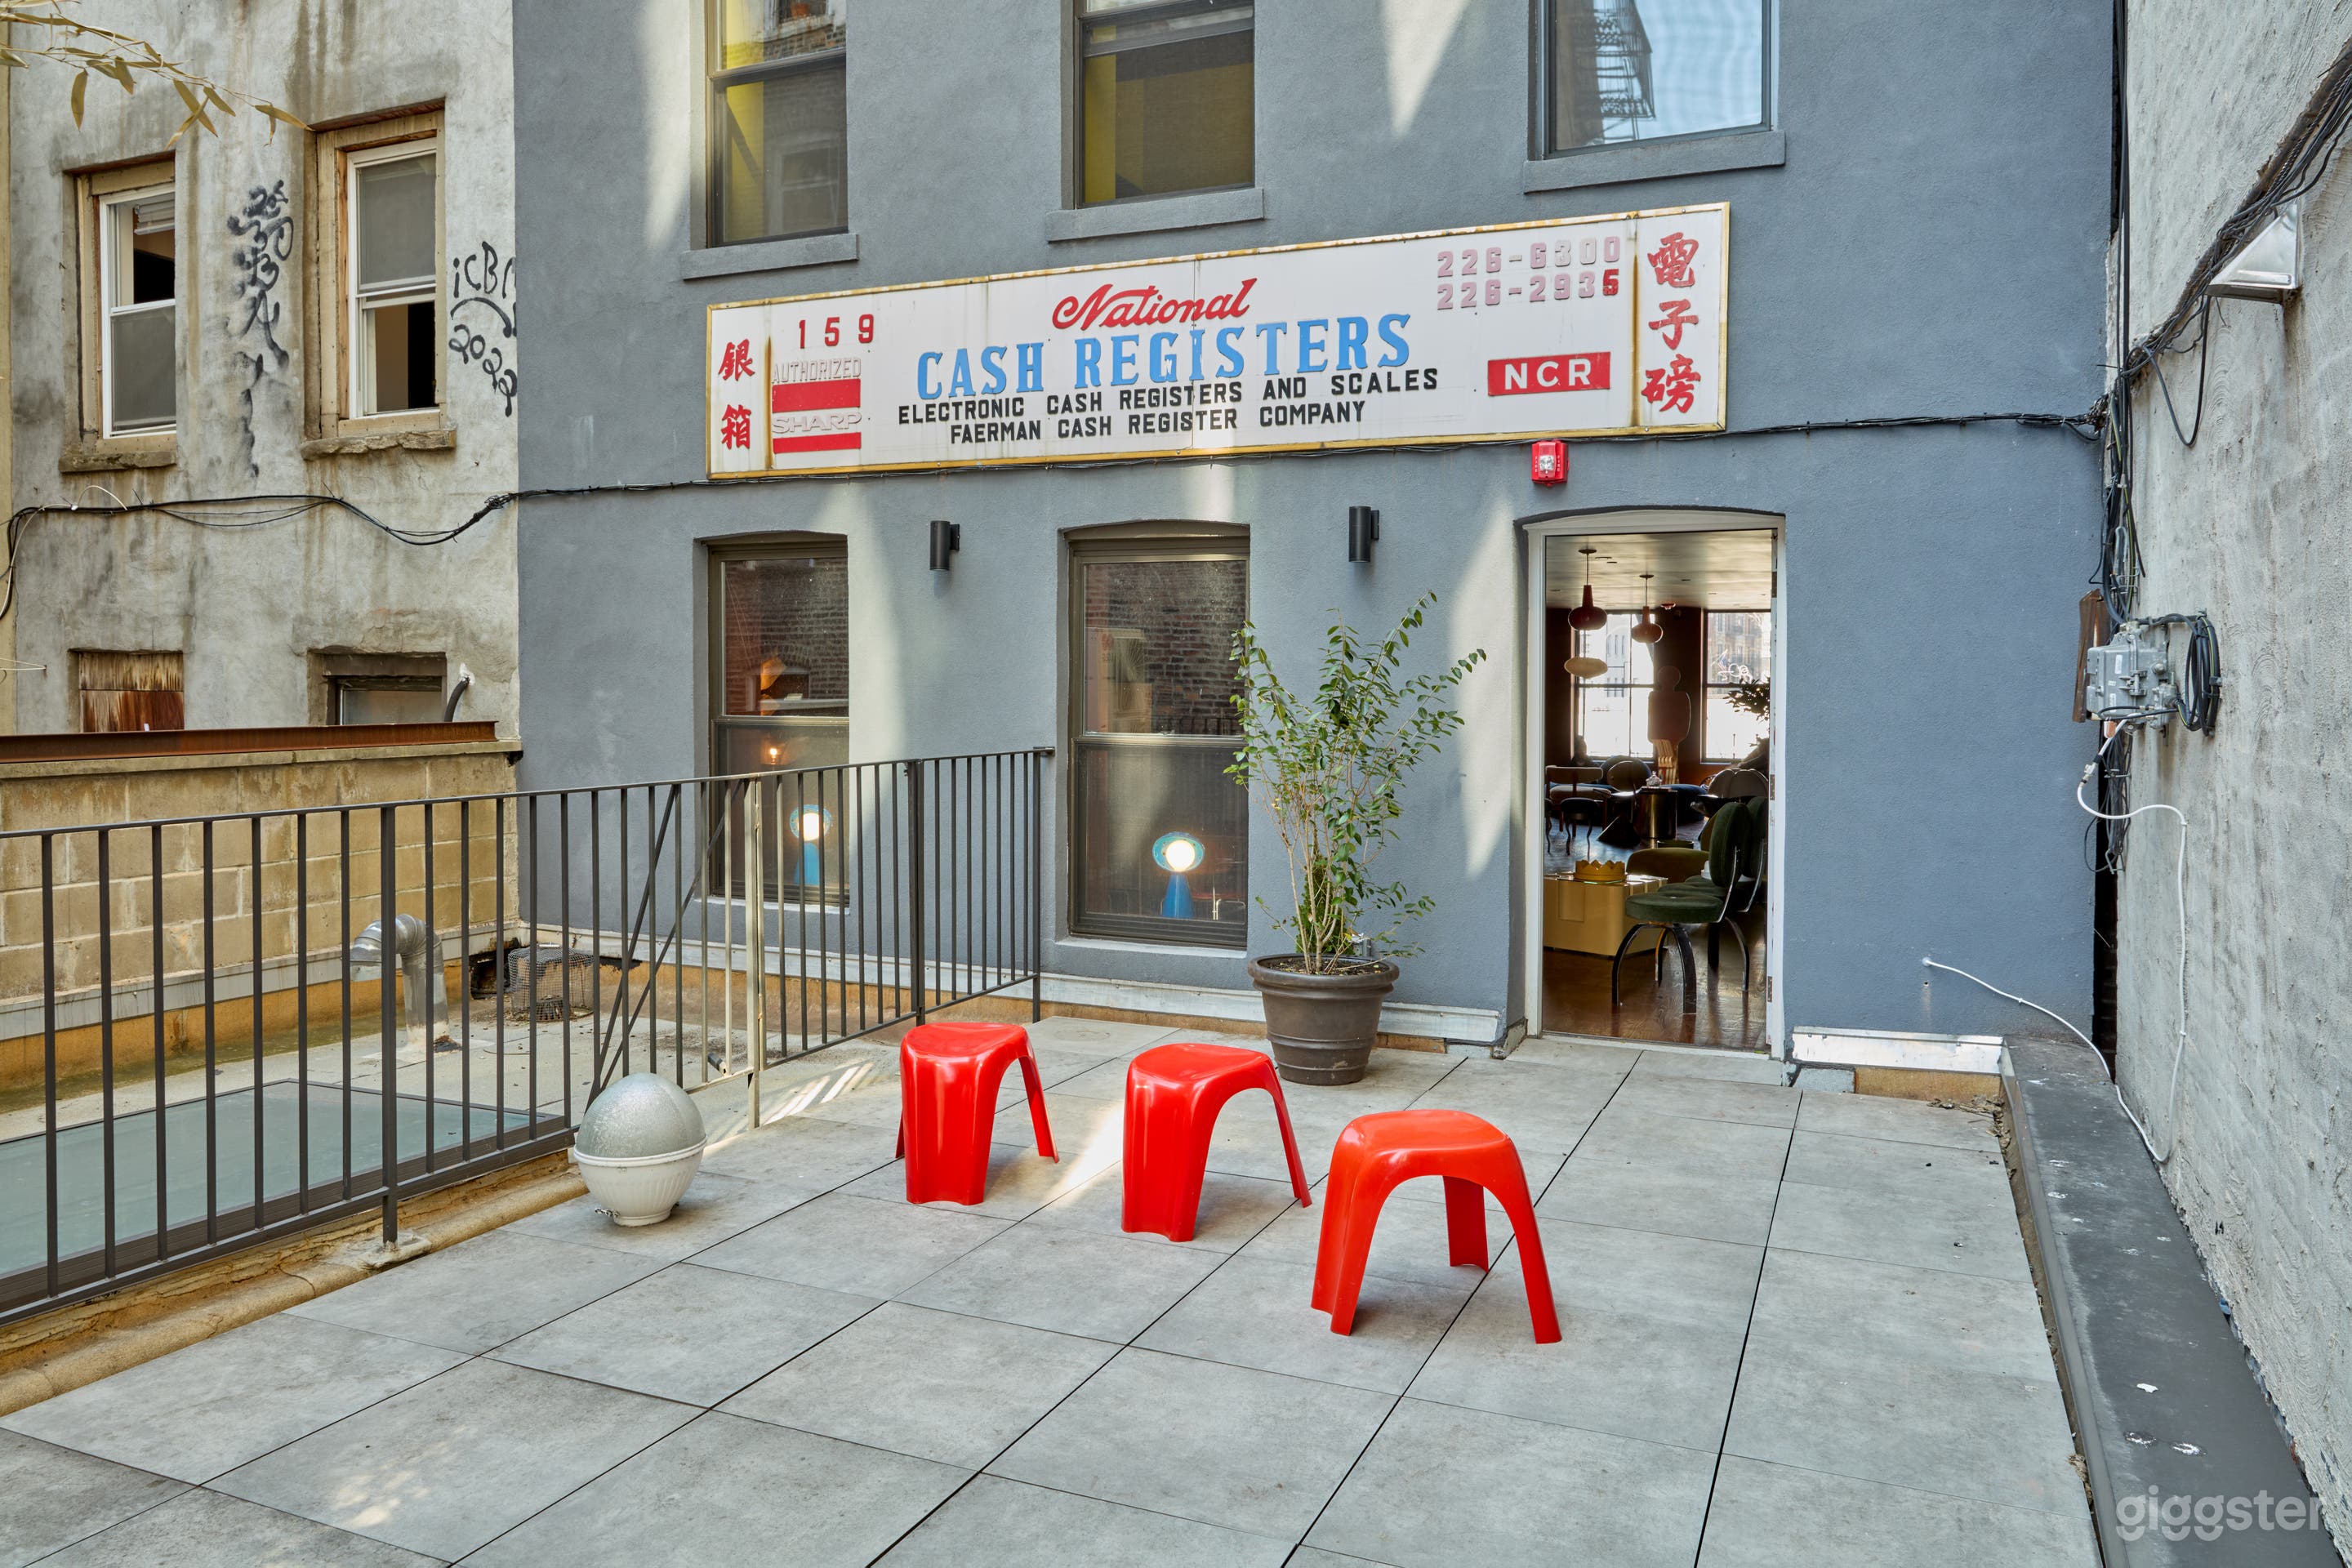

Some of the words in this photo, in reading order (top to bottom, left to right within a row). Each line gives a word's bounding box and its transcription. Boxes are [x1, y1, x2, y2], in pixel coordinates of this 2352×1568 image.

[1437, 236, 1620, 278] 226-6300
[1052, 278, 1258, 331] National
[1437, 269, 1619, 310] 226-2935
[1642, 232, 1702, 414] 電子磅
[772, 357, 862, 384] AUTHORIZED
[917, 341, 1045, 400] CASH
[1075, 314, 1411, 389] REGISTERS
[1504, 358, 1592, 390] NCR
[898, 397, 1024, 424] ELECTRONIC
[1047, 391, 1102, 415] CASH
[1120, 381, 1242, 410] REGISTERS
[1263, 376, 1307, 400] AND
[1331, 368, 1438, 396] SCALES
[771, 411, 862, 434] SHARP
[951, 420, 1041, 444] FAERMAN
[1058, 415, 1111, 439] CASH
[1129, 408, 1237, 434] REGISTER
[1259, 400, 1365, 427] COMPANY
